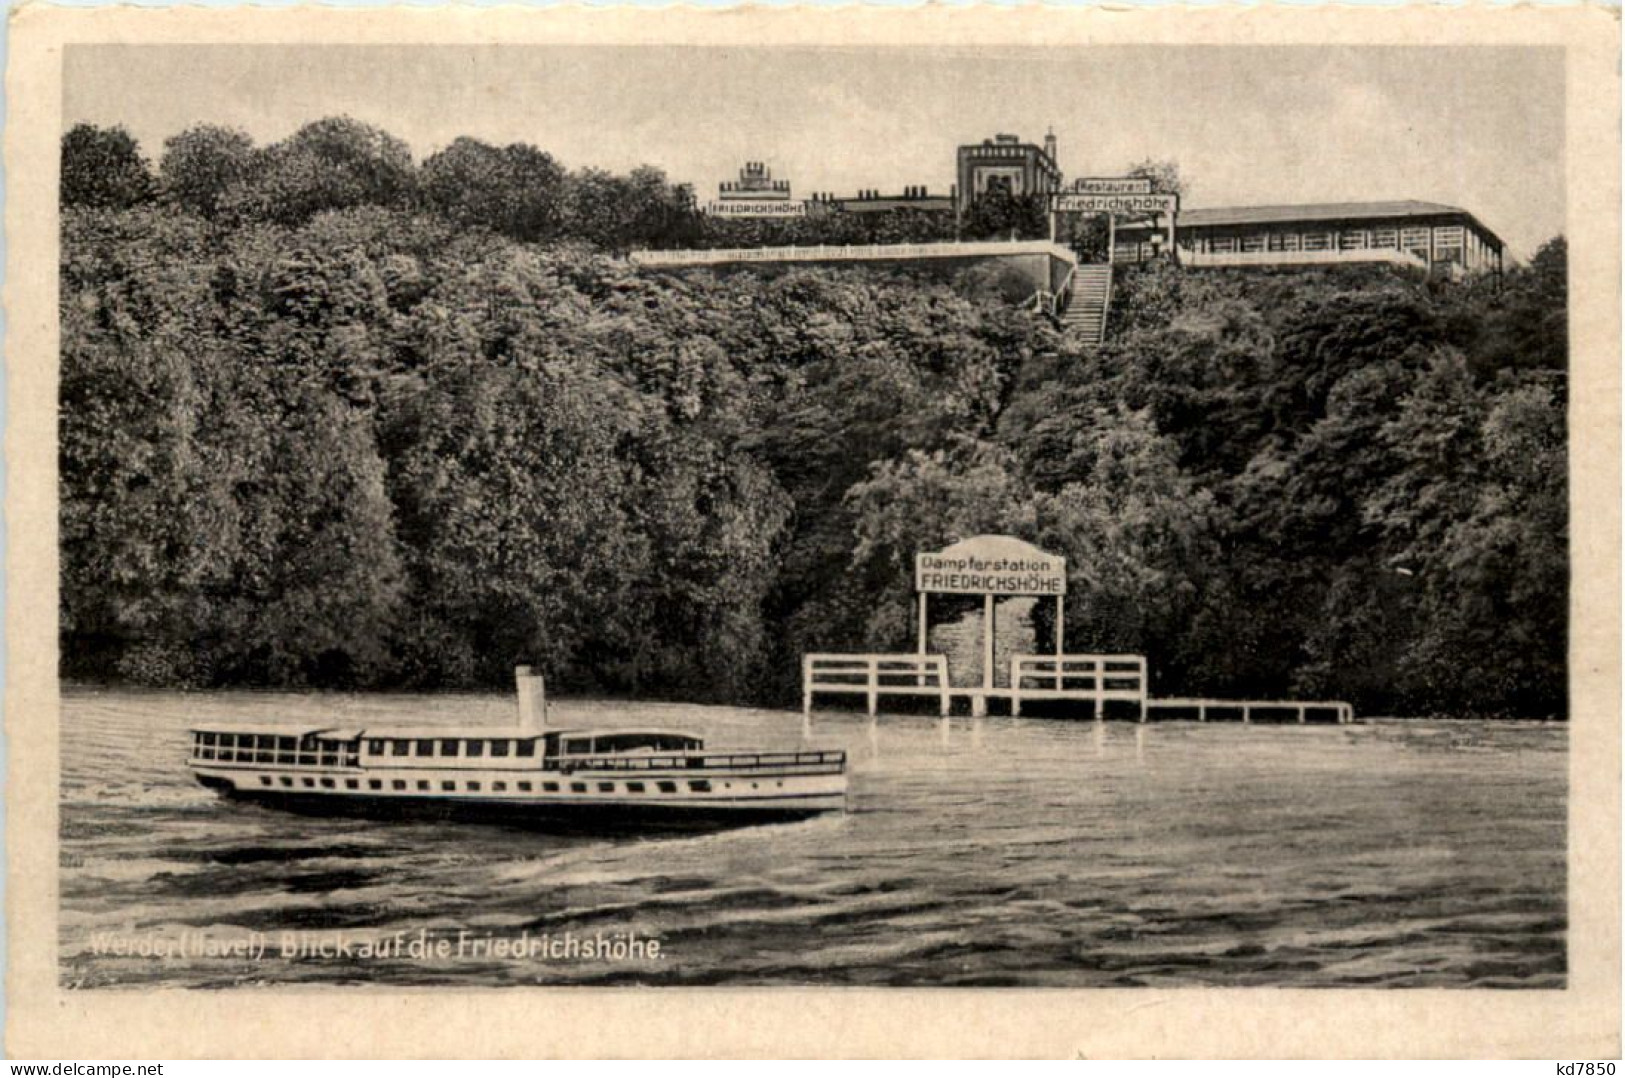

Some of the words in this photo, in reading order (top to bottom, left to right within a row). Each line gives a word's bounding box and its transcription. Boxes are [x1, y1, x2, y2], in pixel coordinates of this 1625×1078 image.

[712, 203, 802, 213] FRIEDRICHSHÖHE
[1056, 196, 1170, 213] Friedrichshöhe
[921, 556, 1050, 573] Dampferstation
[921, 573, 1061, 592] FRIEDRICHSHÖHE
[281, 931, 353, 958] Blick
[359, 931, 405, 958] auf
[408, 929, 450, 959] die
[458, 930, 666, 959] Friedrichshöhe.
